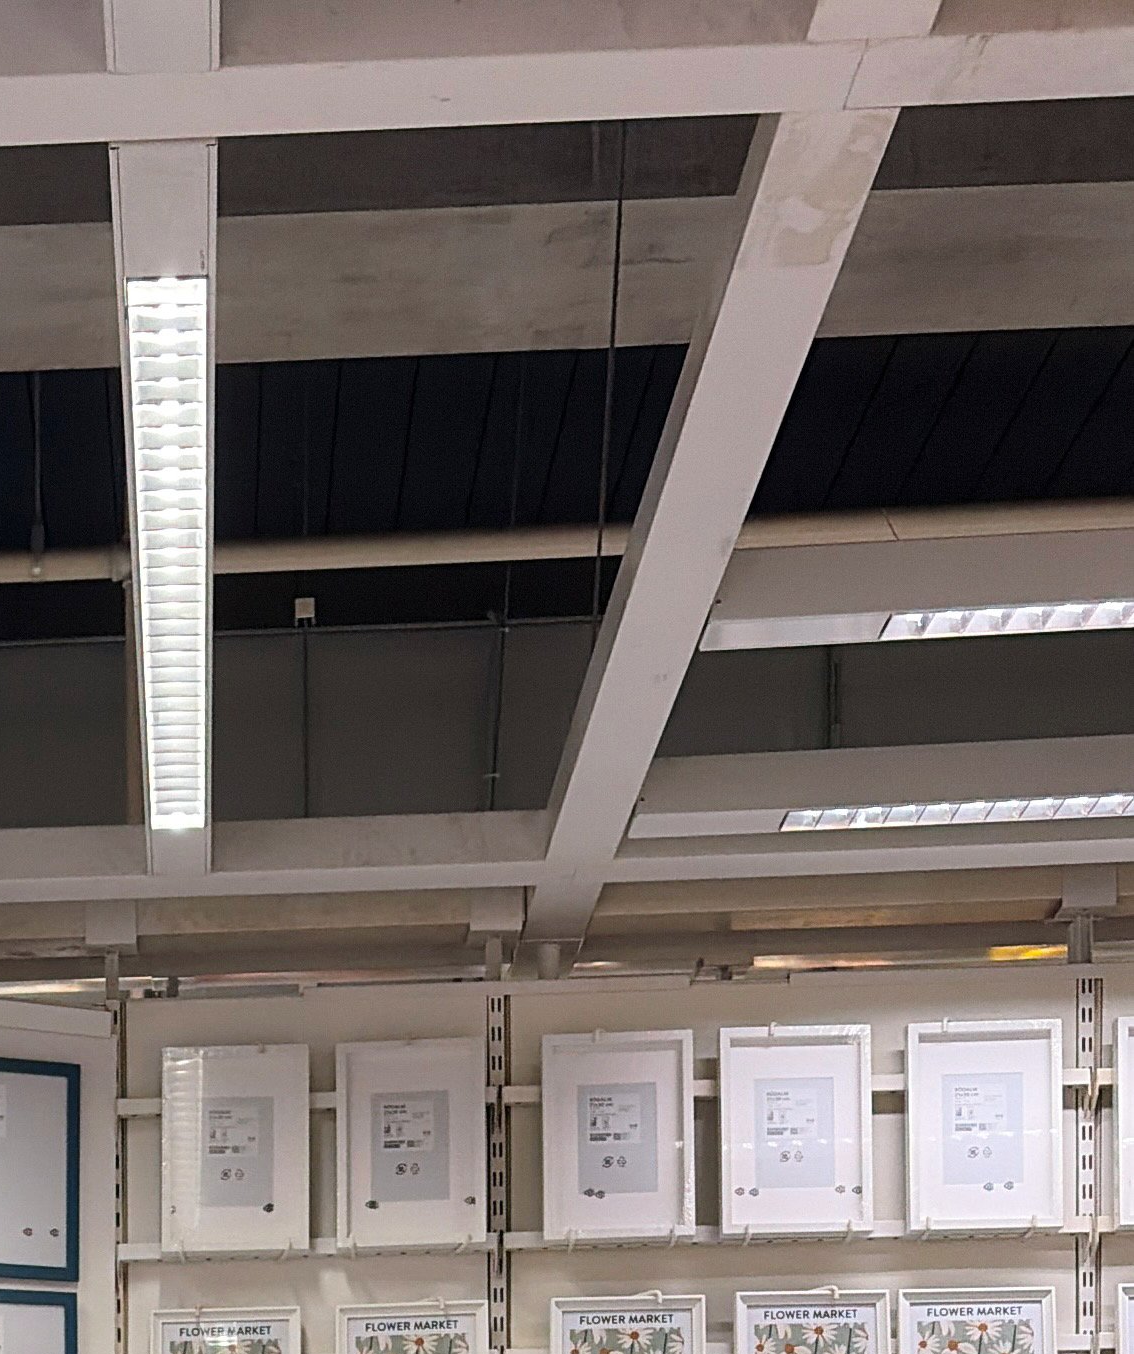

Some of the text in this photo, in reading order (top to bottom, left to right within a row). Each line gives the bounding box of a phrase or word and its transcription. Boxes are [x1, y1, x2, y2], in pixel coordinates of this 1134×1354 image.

[763, 1309, 858, 1320] FLOWER MARKET
[926, 1306, 1024, 1318] FLOWER MARKET
[365, 1319, 458, 1332] FLOWER MARKET
[579, 1314, 674, 1326] FLOWER MARKET
[179, 1326, 272, 1338] FLOWER MARKET
